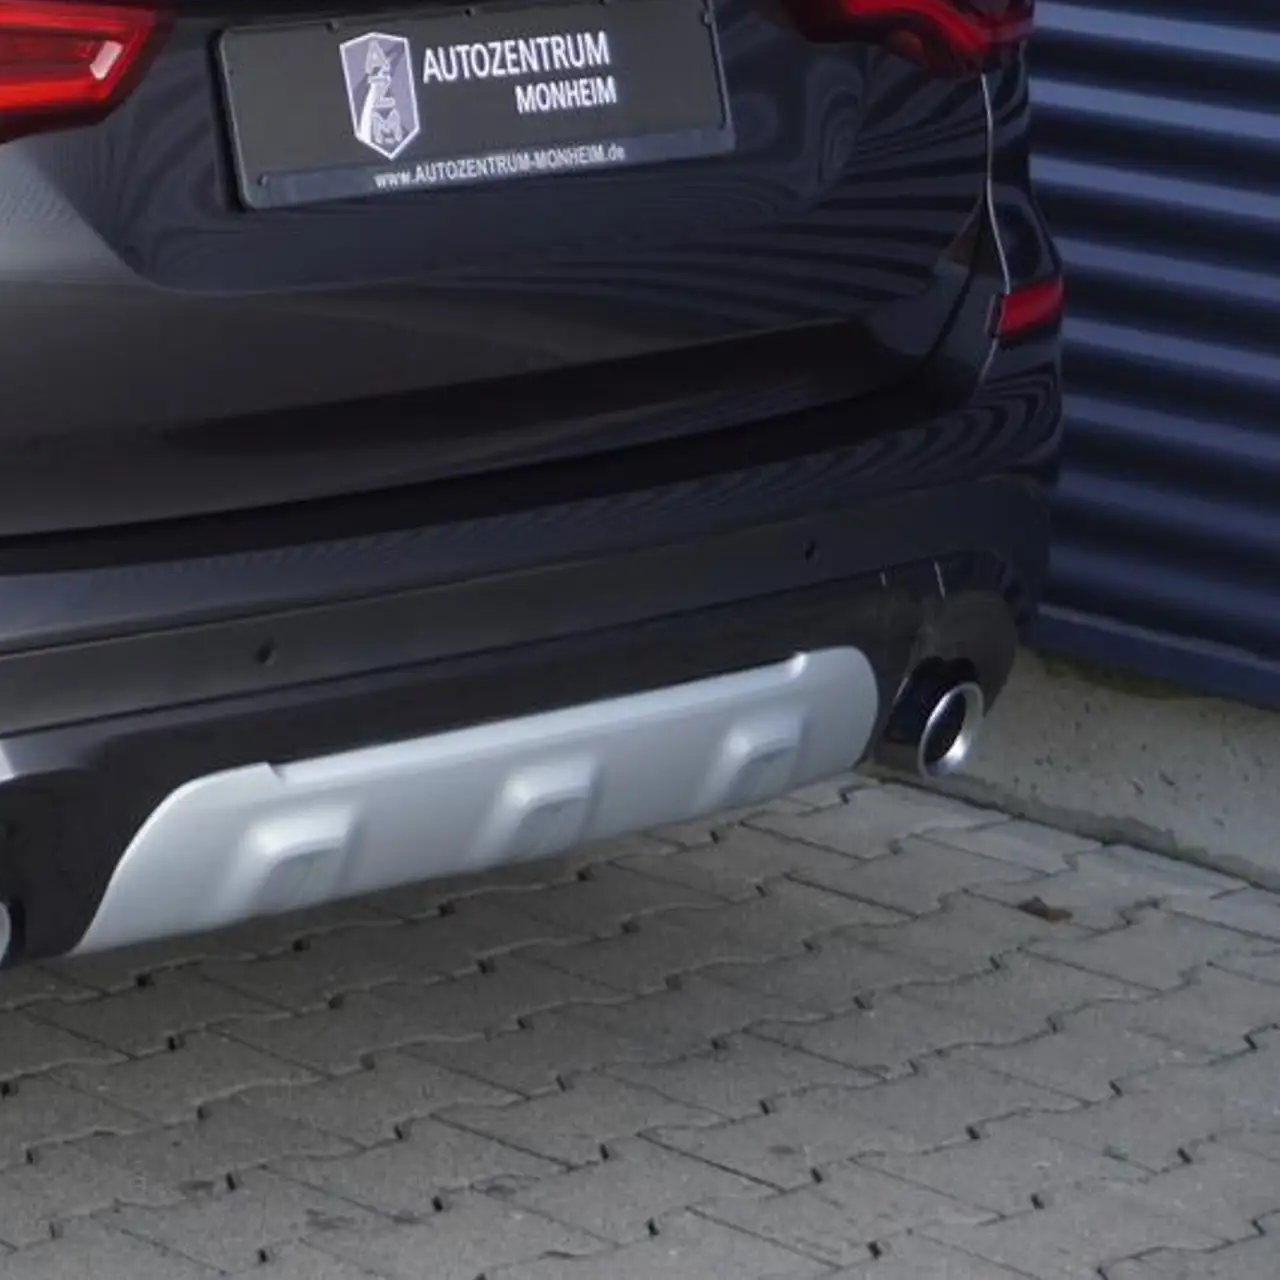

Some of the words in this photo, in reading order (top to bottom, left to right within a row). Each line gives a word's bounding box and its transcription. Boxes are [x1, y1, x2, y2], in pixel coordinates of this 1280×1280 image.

[422, 31, 610, 84] AUTOZENTRUM
[515, 76, 617, 115] MONHEIM
[374, 142, 626, 189] www.AUTOZENTRUM-MONHEIM.de
